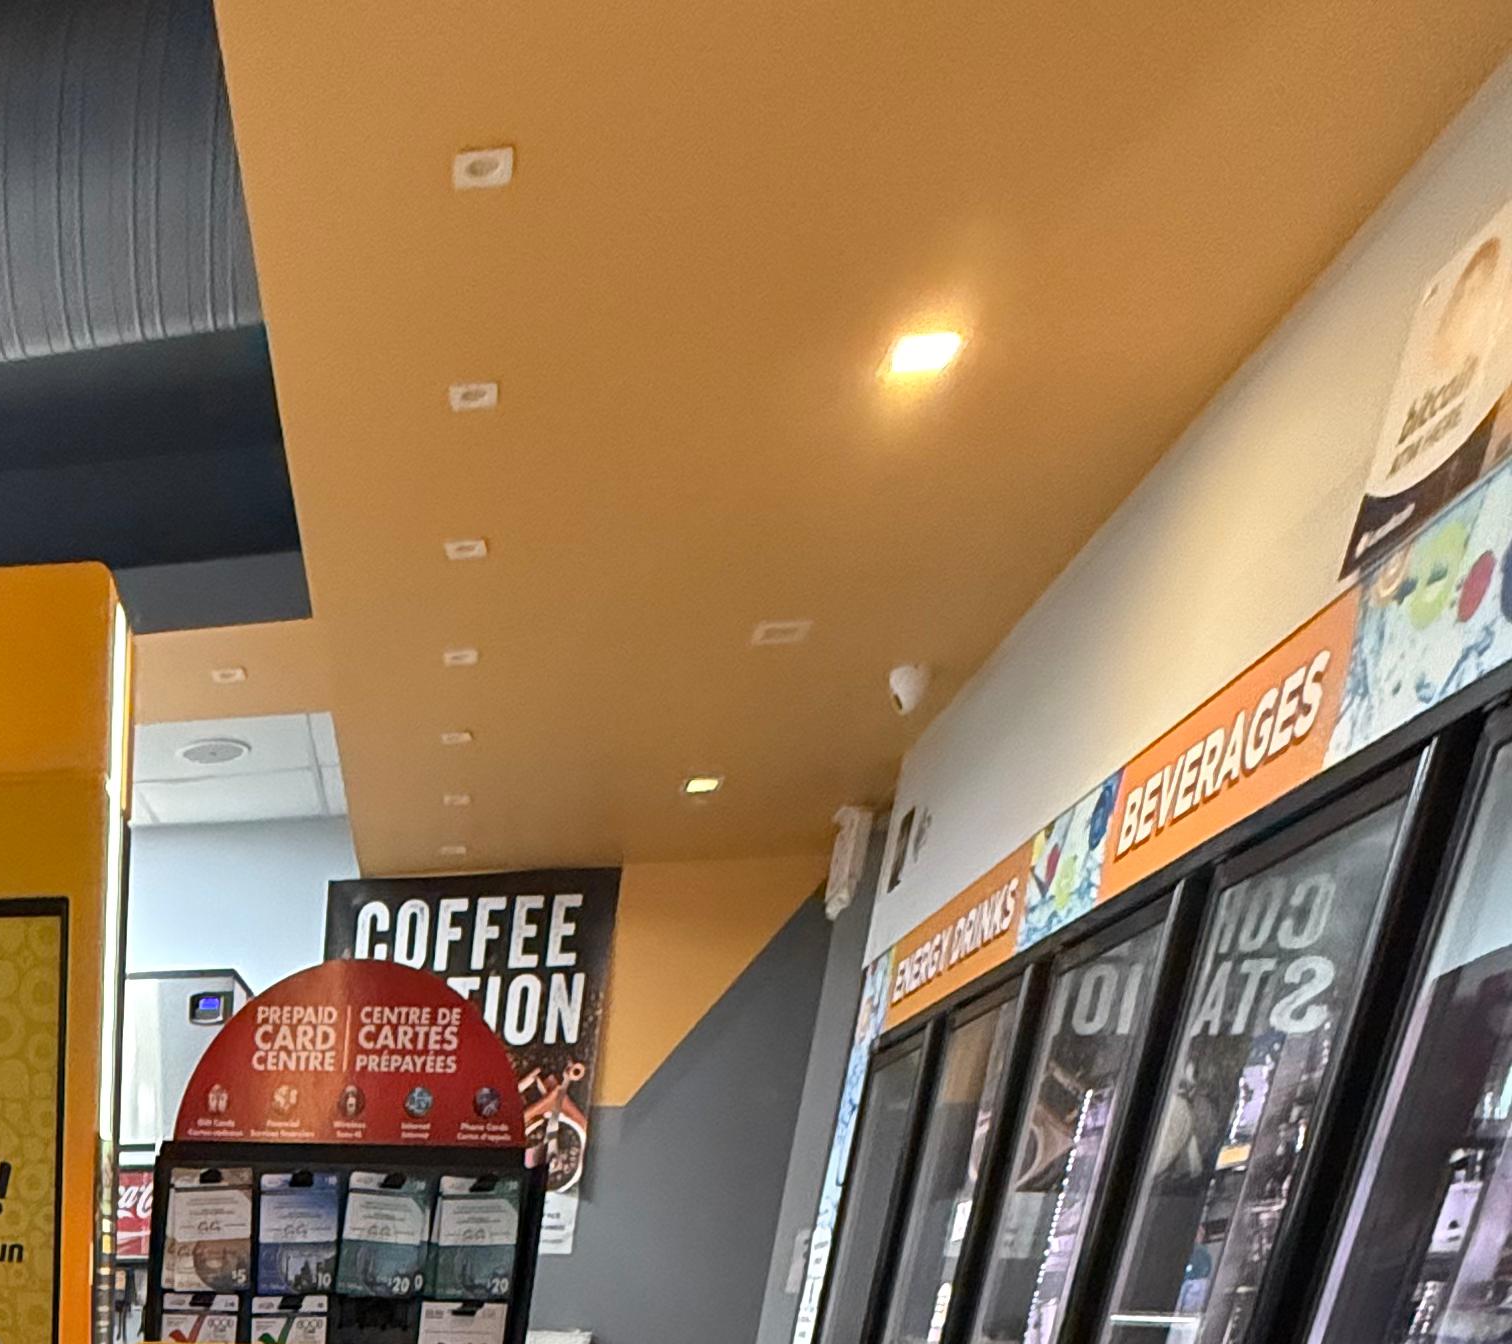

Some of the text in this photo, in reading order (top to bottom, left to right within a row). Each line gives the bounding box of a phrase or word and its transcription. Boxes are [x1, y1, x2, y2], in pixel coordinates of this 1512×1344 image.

[1115, 650, 1333, 861] BEVERAGES
[354, 894, 584, 971] COFFEE
[892, 877, 1019, 1004] ENERGY DRINKS
[256, 1005, 338, 1025] PREPAID
[360, 1006, 462, 1026] CENTRE DE
[447, 972, 585, 1046] TION
[254, 1025, 337, 1051] CARD
[357, 1025, 459, 1051] CARTES
[251, 1051, 337, 1072] CENTRE
[355, 1050, 458, 1074] PRÉPAYÉES
